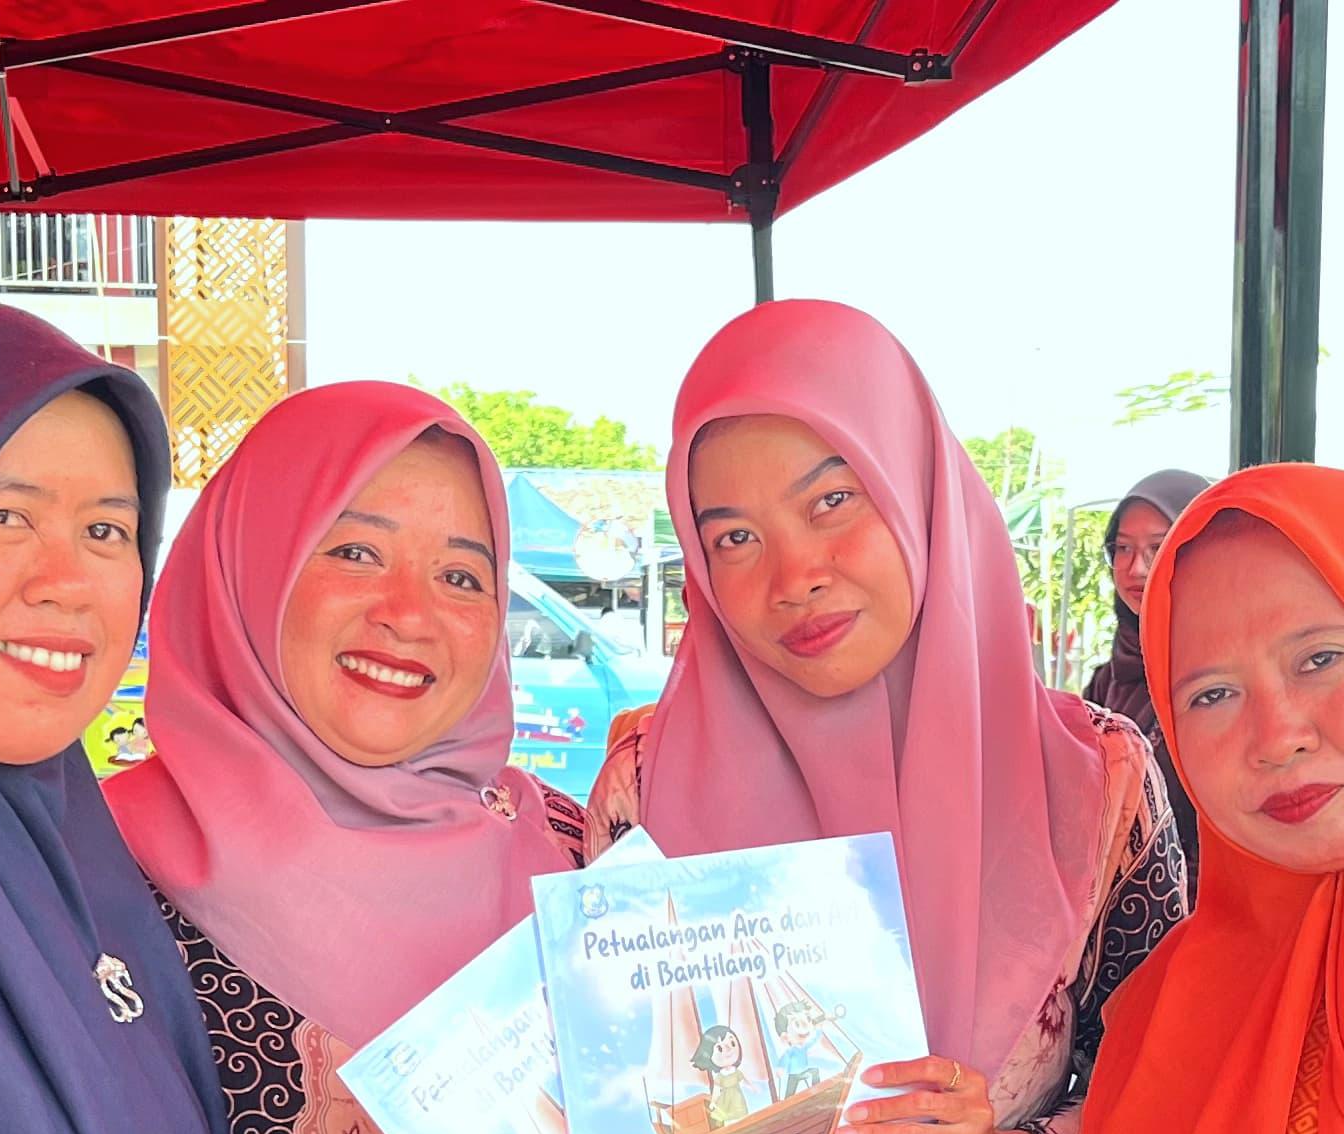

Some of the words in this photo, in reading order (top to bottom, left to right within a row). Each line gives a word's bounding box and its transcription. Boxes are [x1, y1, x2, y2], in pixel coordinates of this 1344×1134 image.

[583, 921, 725, 960] Petualangan
[733, 913, 774, 940] Ara
[780, 905, 821, 932] dan
[630, 963, 650, 991] di
[657, 951, 767, 988] Bantilang
[772, 939, 828, 970] Pinisi
